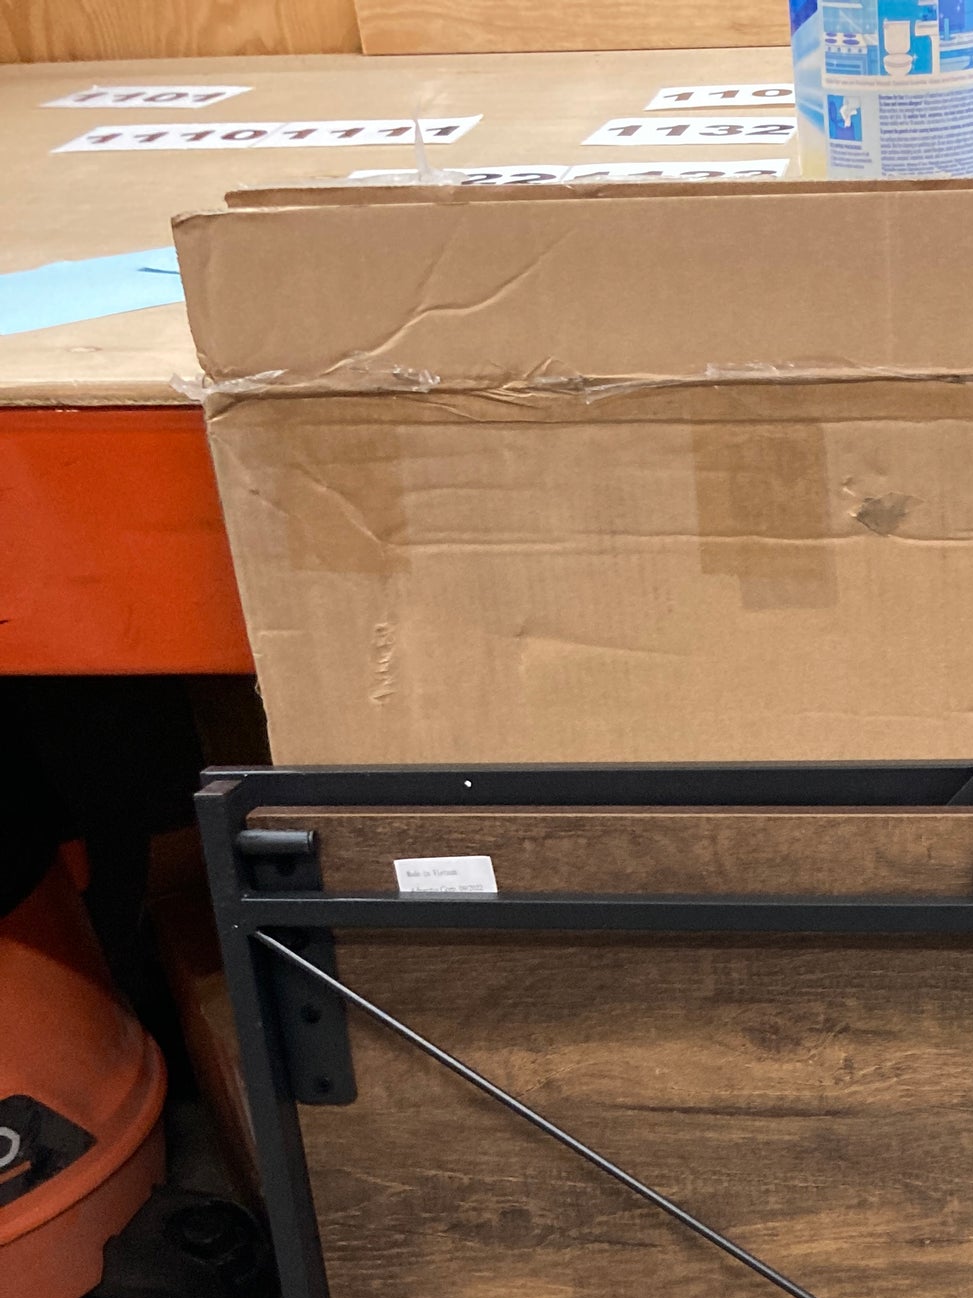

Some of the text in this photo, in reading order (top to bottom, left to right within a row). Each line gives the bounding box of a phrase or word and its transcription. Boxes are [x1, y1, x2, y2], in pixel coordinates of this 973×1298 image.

[73, 91, 227, 103] 1101
[663, 88, 793, 102] 110
[86, 125, 461, 145] 1110 1111
[608, 124, 795, 137] 1132
[461, 172, 557, 185] 22
